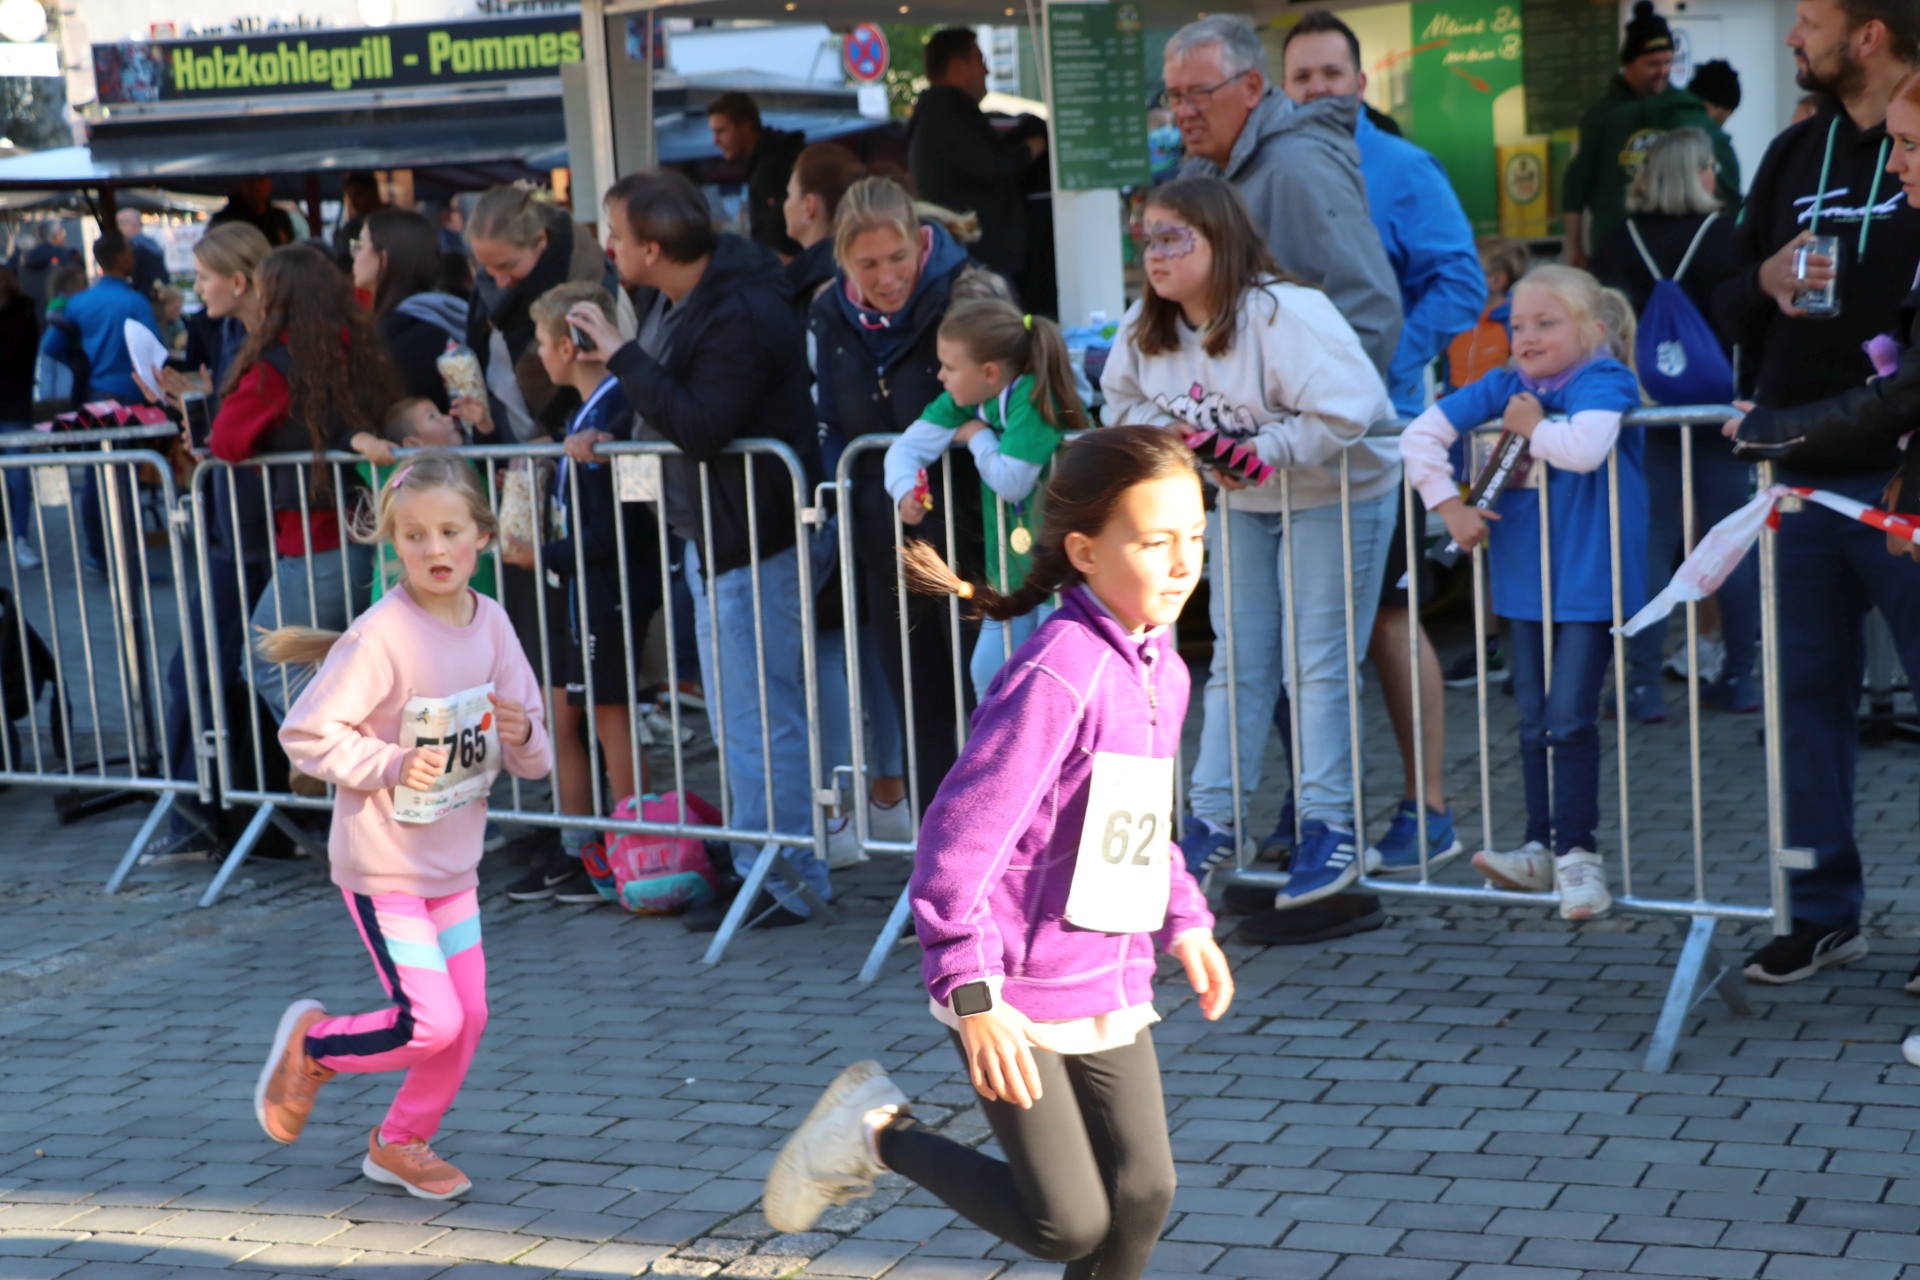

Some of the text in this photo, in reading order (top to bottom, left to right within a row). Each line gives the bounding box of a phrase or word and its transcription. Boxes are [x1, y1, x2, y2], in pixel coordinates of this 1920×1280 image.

[172, 36, 393, 91] Holzkohlegrill
[428, 30, 581, 75] Pommes
[416, 724, 486, 774] 765
